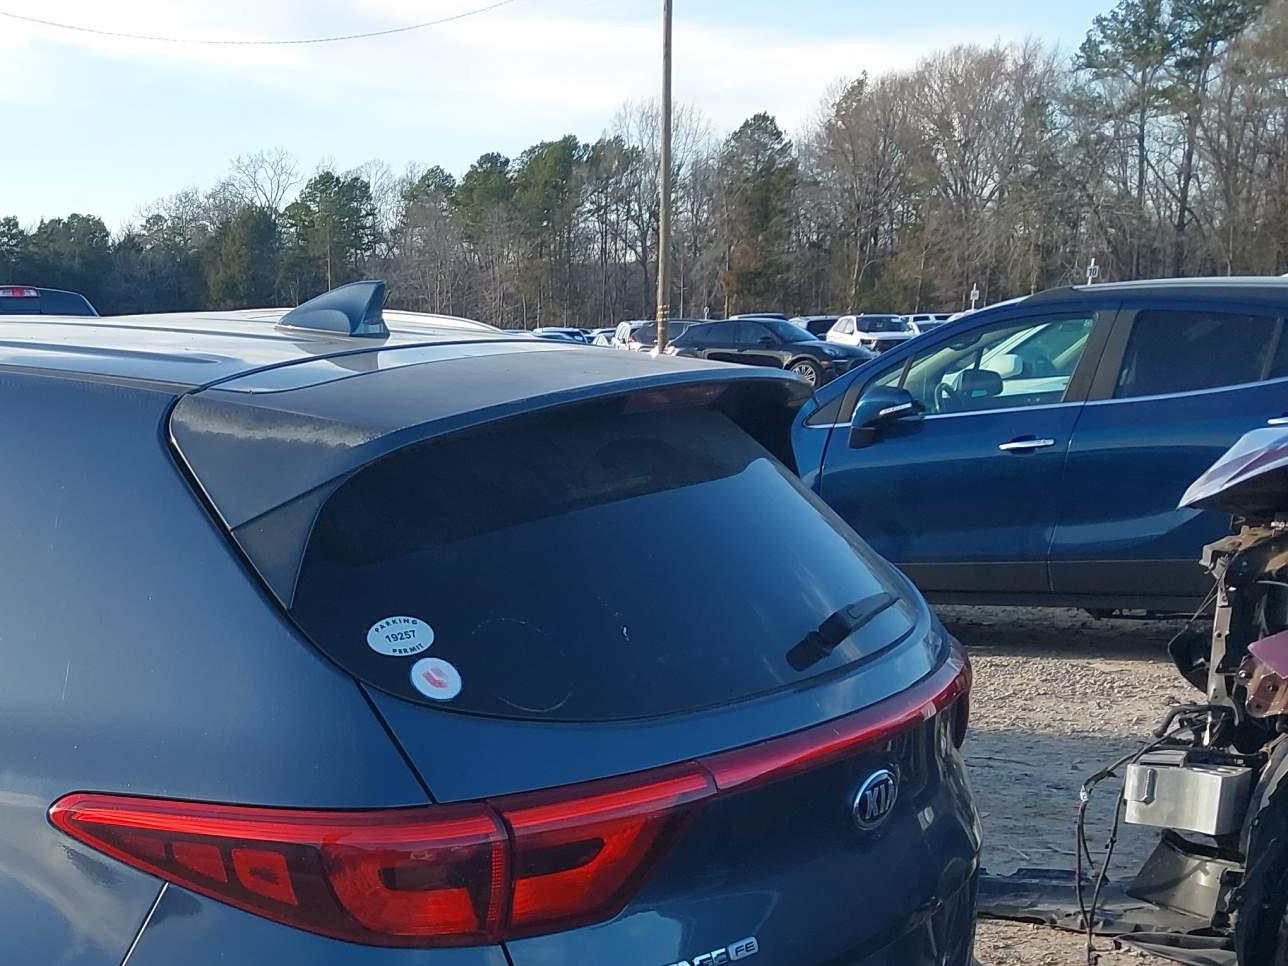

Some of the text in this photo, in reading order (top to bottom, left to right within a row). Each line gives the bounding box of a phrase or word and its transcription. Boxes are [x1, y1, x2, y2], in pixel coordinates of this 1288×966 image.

[374, 618, 419, 633] PARKING
[385, 629, 417, 643] 19257
[392, 642, 425, 655] PERMIT
[864, 782, 895, 820] KIA
[734, 940, 757, 958] FE
